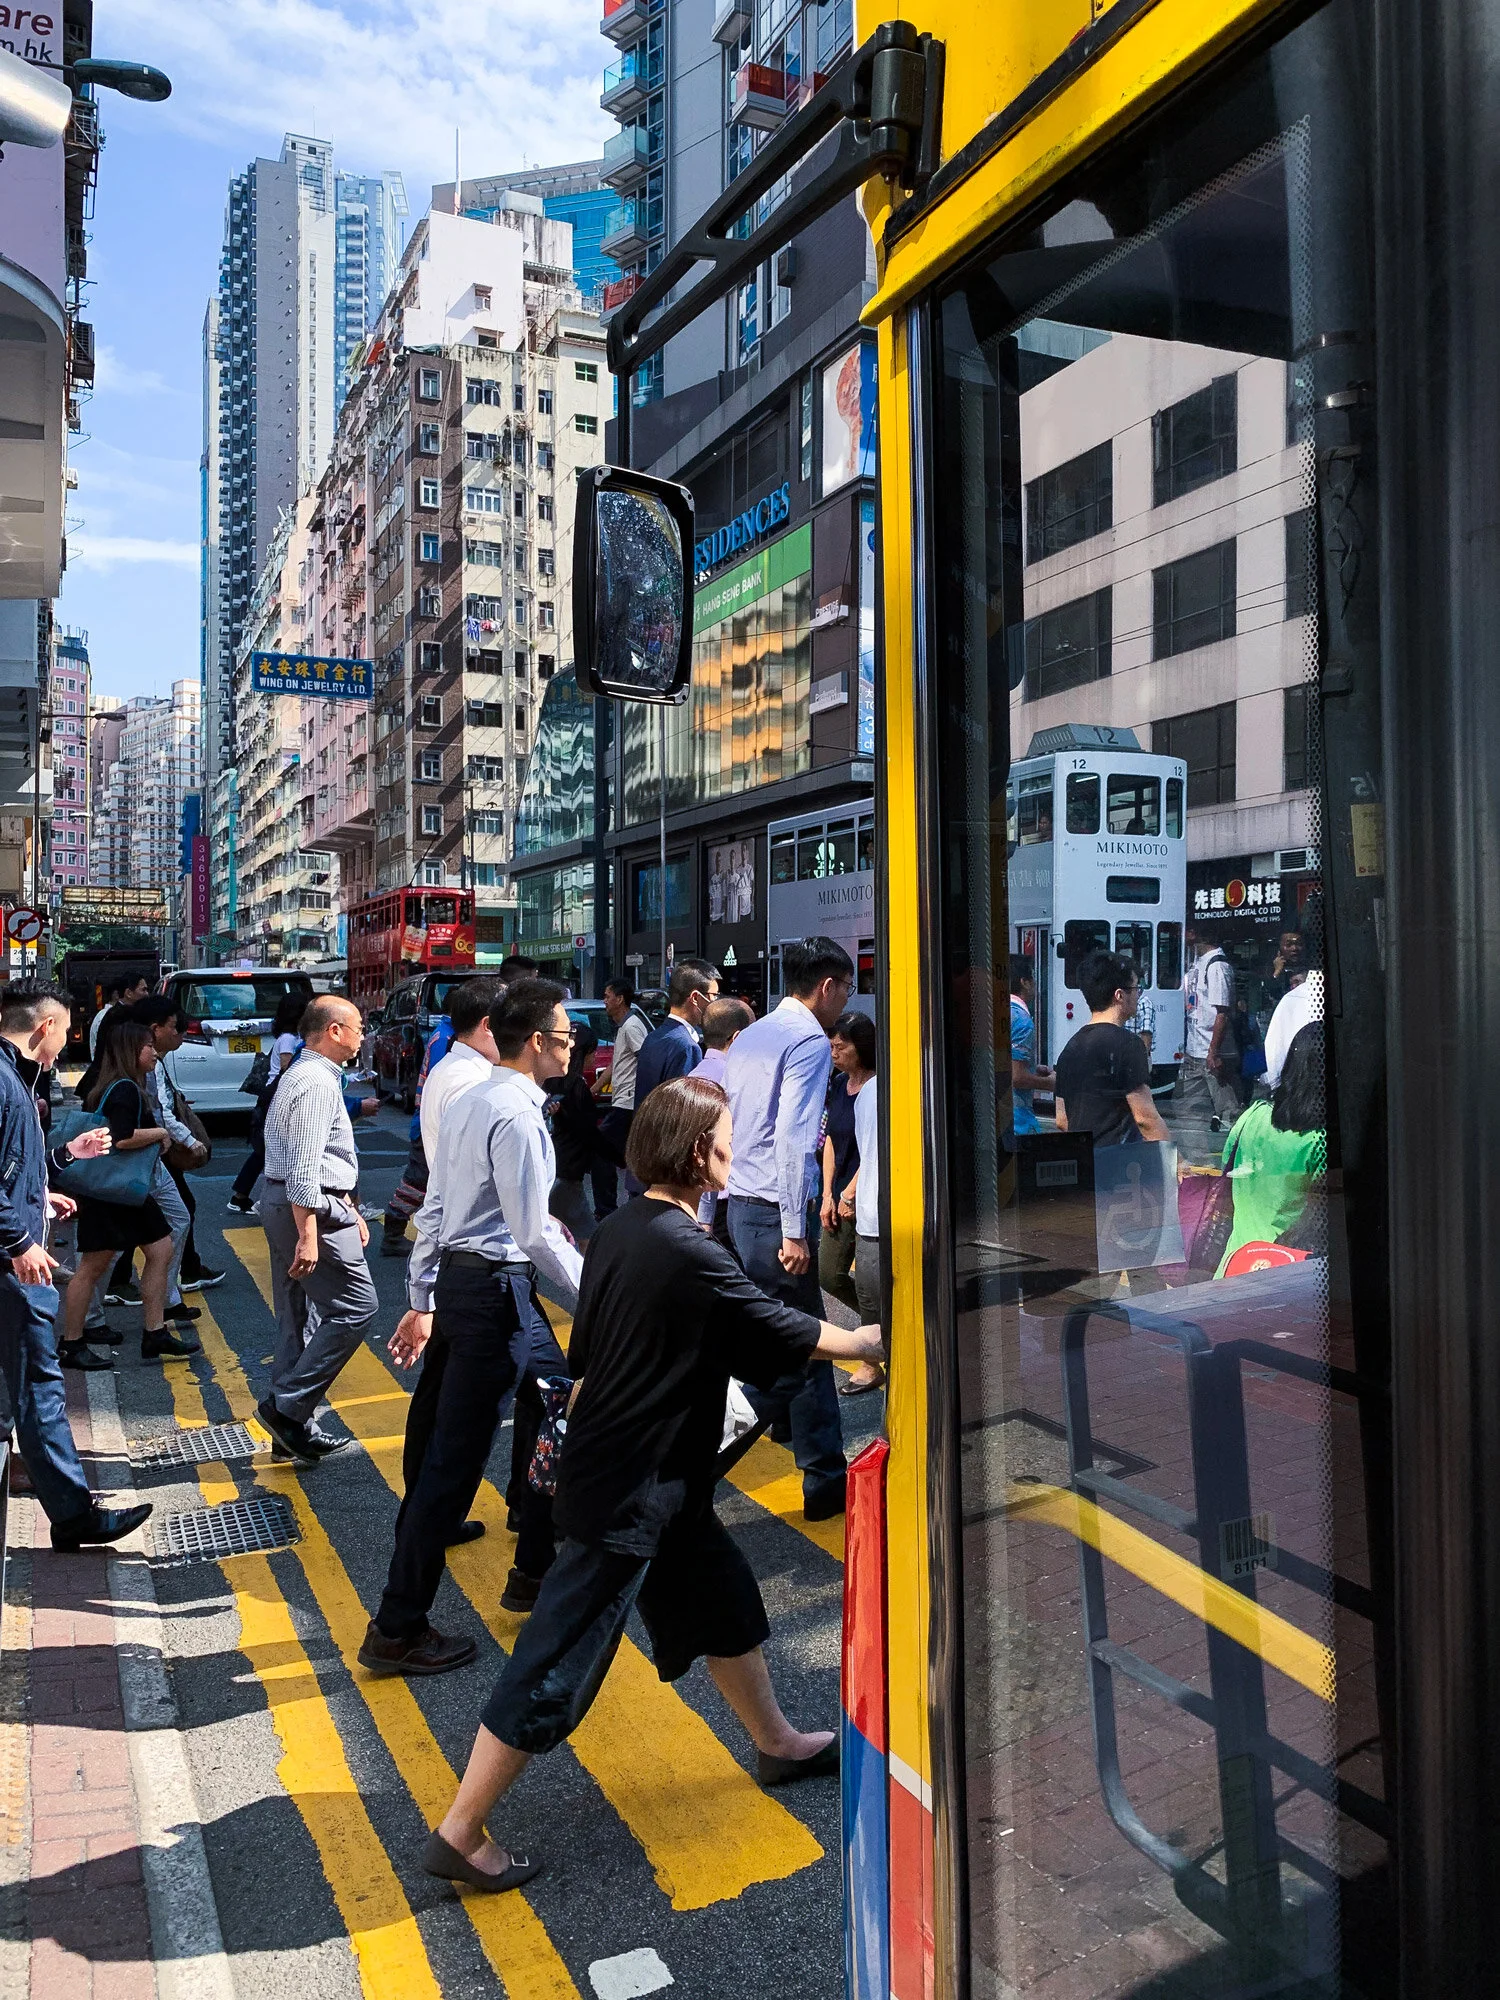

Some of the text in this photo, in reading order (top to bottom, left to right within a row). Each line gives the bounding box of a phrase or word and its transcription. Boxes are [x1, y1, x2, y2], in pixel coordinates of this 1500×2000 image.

[702, 595, 721, 616] HANG
[721, 584, 741, 606] SENG
[741, 569, 763, 594] BANK
[258, 658, 367, 683] 永安珠寶金行
[259, 677, 367, 695] WING ON JEWELRY LTD.
[1093, 727, 1119, 744] 12
[1071, 758, 1087, 769] 12
[1174, 766, 1183, 777] 12
[1096, 842, 1169, 857] MIKIMOTO
[817, 884, 873, 906] MIKIMOTO
[1194, 882, 1281, 910] 先達 科技
[1194, 906, 1281, 920] TECHNOLOGY DIGITAL CO LTD
[1234, 1557, 1267, 1575] 8101
